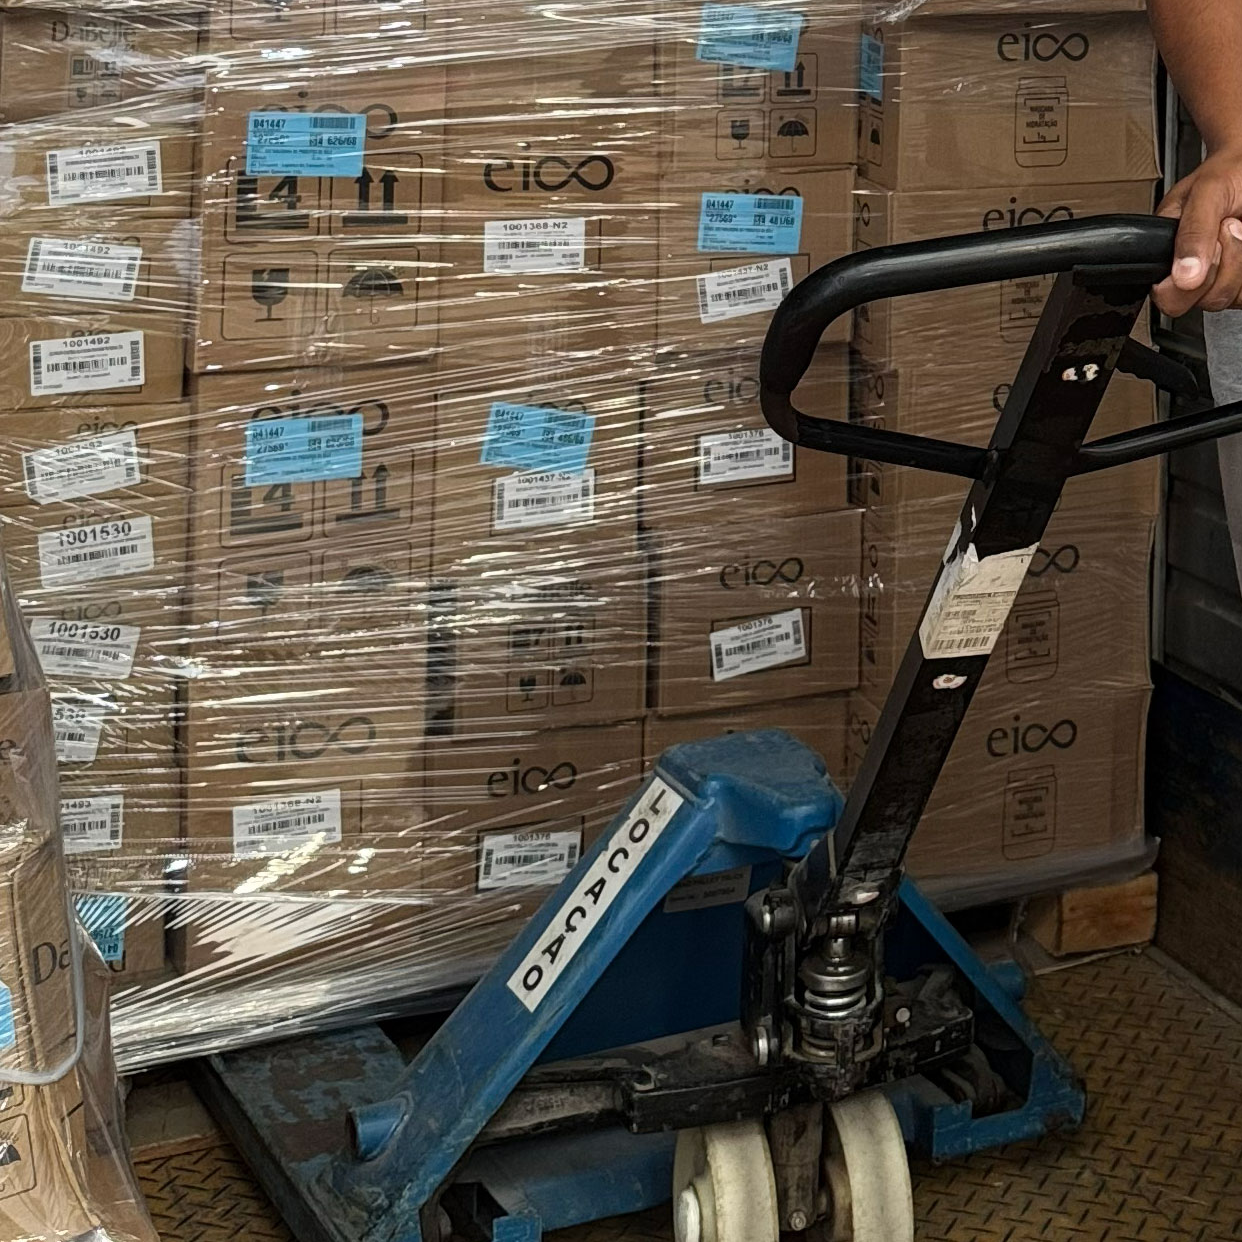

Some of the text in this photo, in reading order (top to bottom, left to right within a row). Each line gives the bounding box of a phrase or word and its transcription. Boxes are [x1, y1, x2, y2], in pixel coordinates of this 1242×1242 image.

[62, 336, 111, 349] 1001492
[57, 521, 133, 547] 1001530
[48, 621, 122, 642] 1001530
[987, 714, 1078, 758] eico
[486, 757, 578, 798] eico
